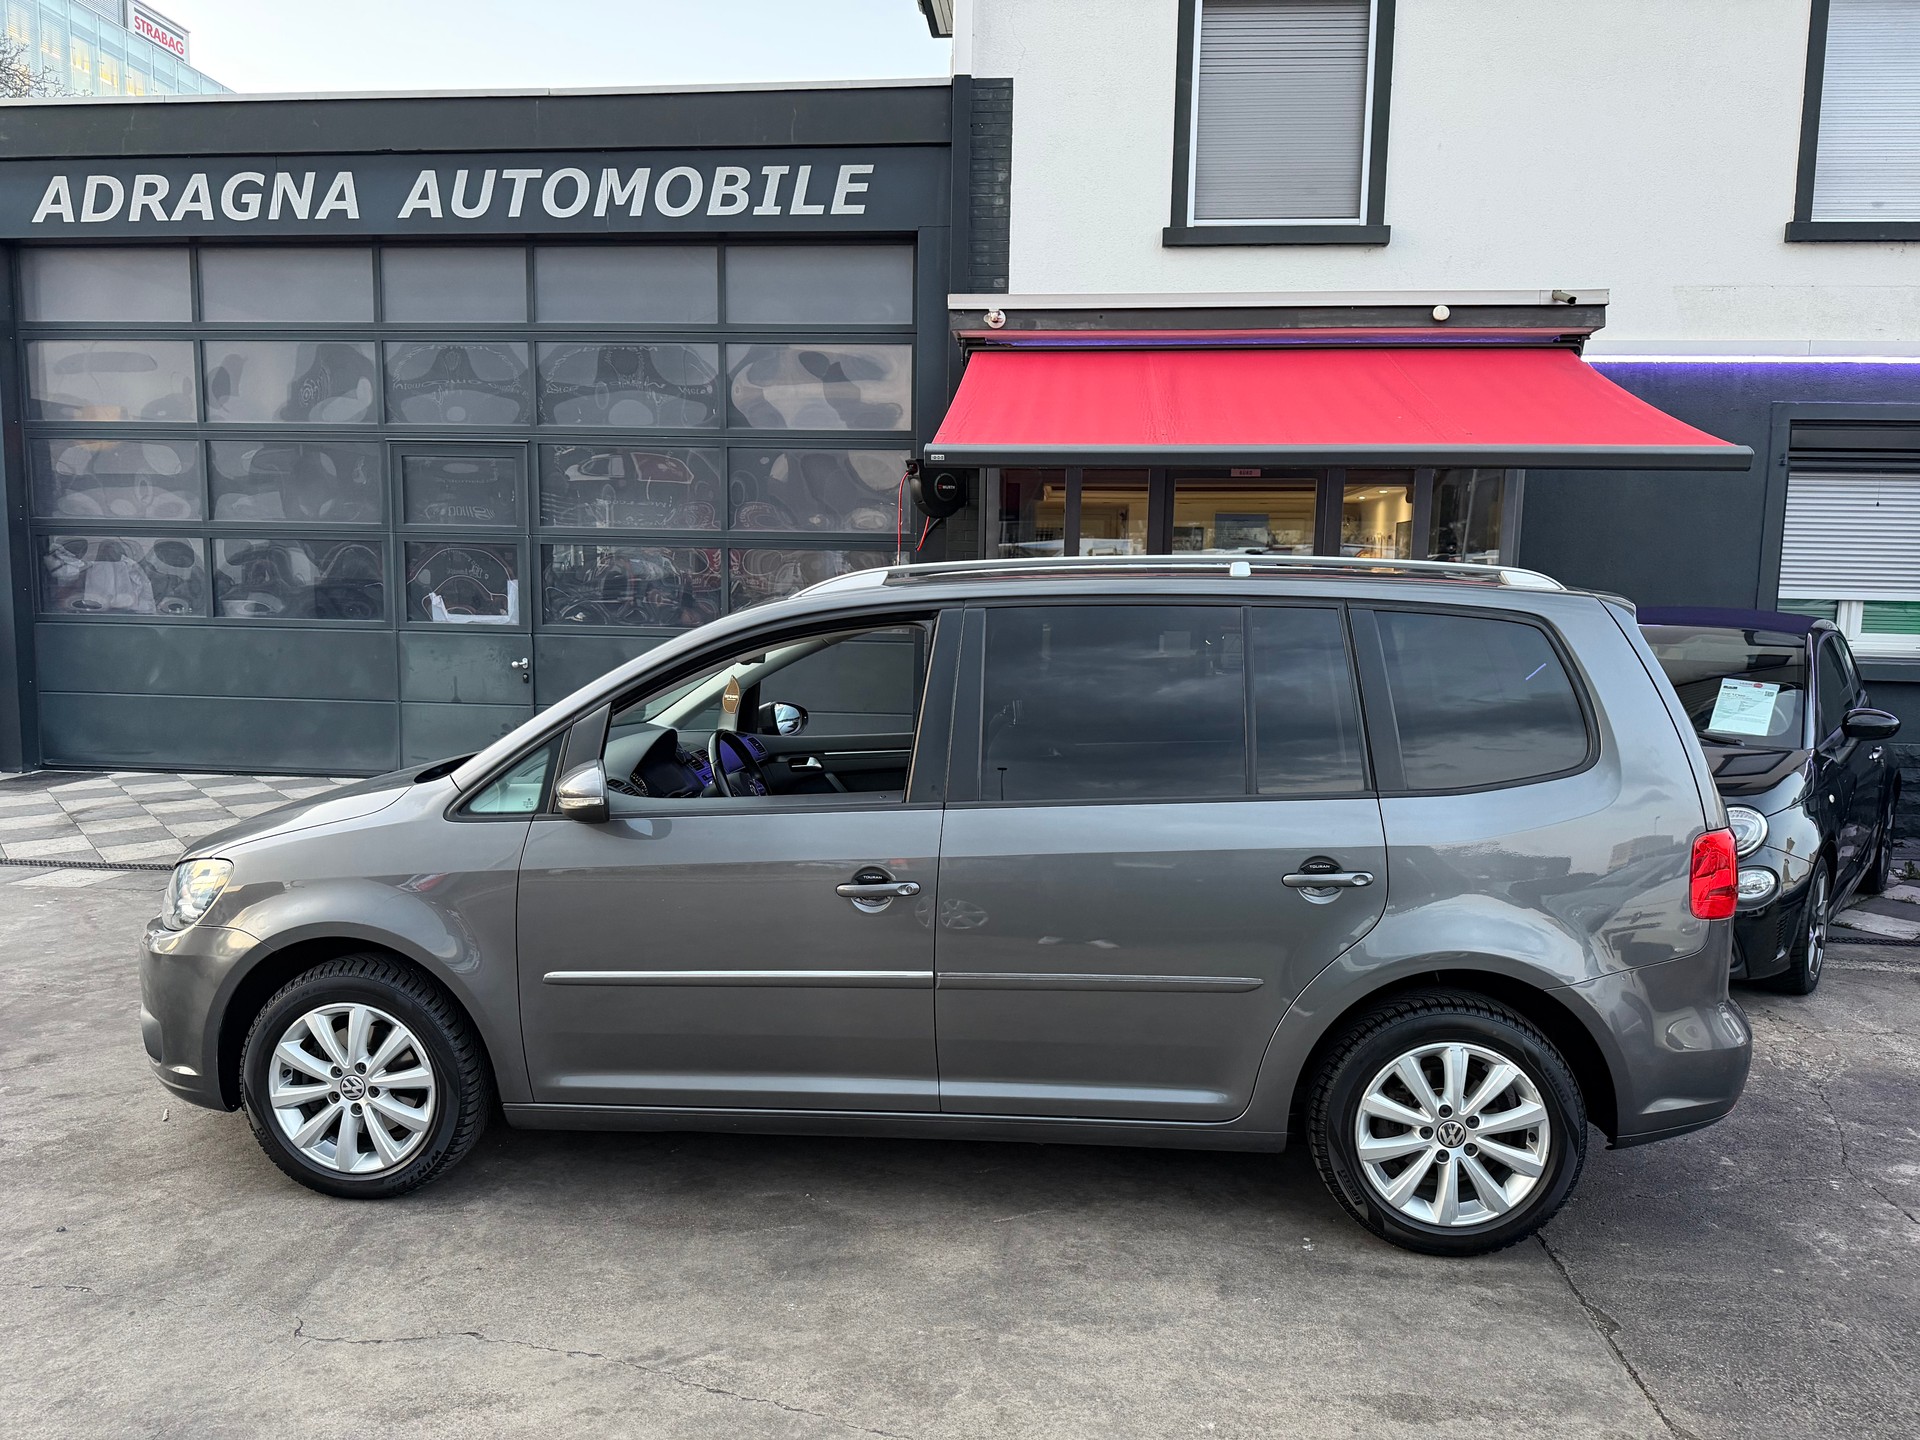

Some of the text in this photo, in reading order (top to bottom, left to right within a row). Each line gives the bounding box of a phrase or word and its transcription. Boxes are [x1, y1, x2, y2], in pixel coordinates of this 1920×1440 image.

[134, 15, 185, 55] STRABAG
[31, 164, 875, 223] ADRAGNA AUTOMOBILE
